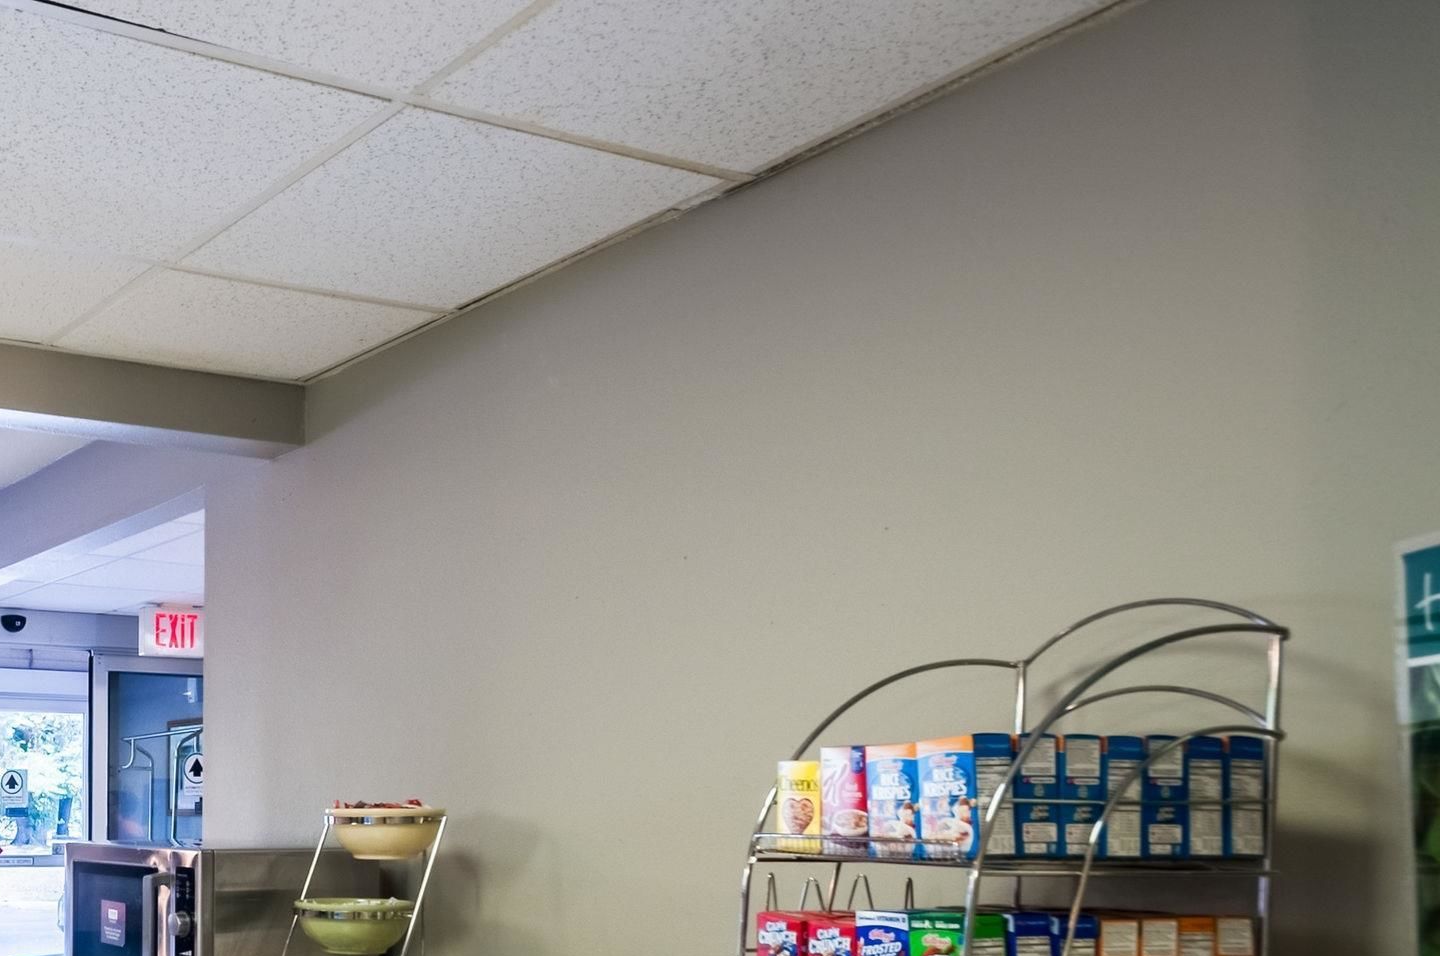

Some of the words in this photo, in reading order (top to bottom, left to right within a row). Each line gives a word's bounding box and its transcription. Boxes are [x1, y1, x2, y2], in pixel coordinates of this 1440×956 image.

[154, 613, 199, 649] EXIT
[879, 772, 900, 786] RICE
[932, 767, 955, 781] RICE
[871, 785, 911, 801] KRISPIES
[922, 780, 968, 798] KRISPIES
[759, 930, 797, 946] CRUNCH
[809, 936, 852, 954] CRUNCH
[861, 941, 902, 956] FROSTED
